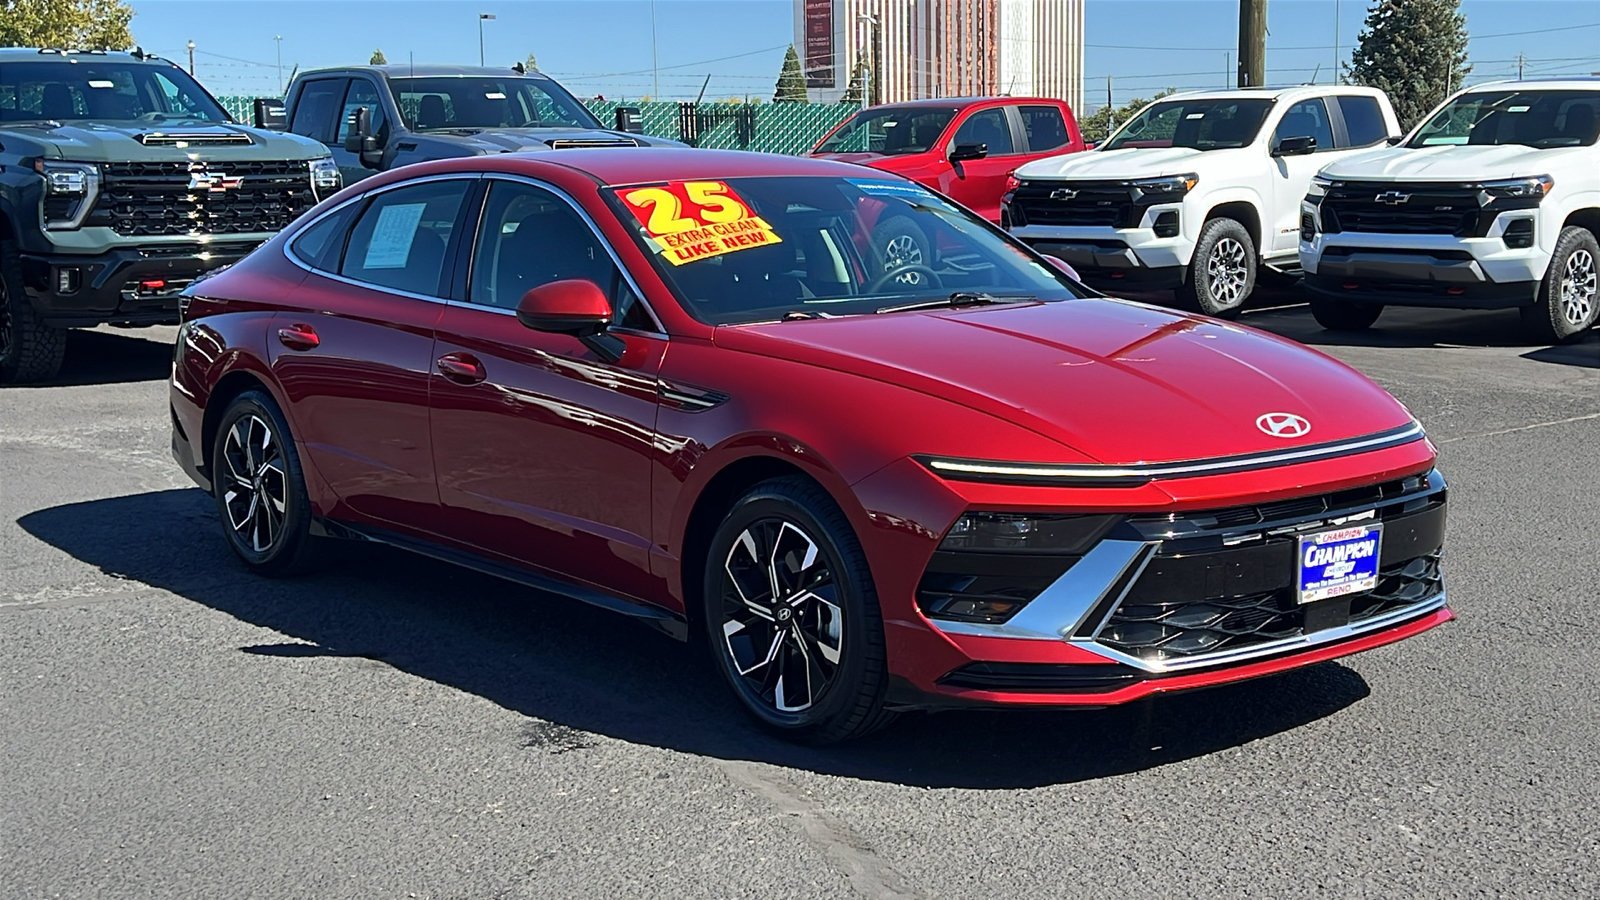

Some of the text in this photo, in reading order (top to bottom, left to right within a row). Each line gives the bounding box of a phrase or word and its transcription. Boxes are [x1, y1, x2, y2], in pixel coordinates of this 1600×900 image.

[625, 182, 748, 234] 25
[664, 219, 761, 247] EXTRA CLEAN
[674, 231, 766, 260] LIKE NEW
[1322, 529, 1362, 543] CHAMPION
[1304, 539, 1376, 568] CHAMPION
[1327, 584, 1352, 596] RENO
